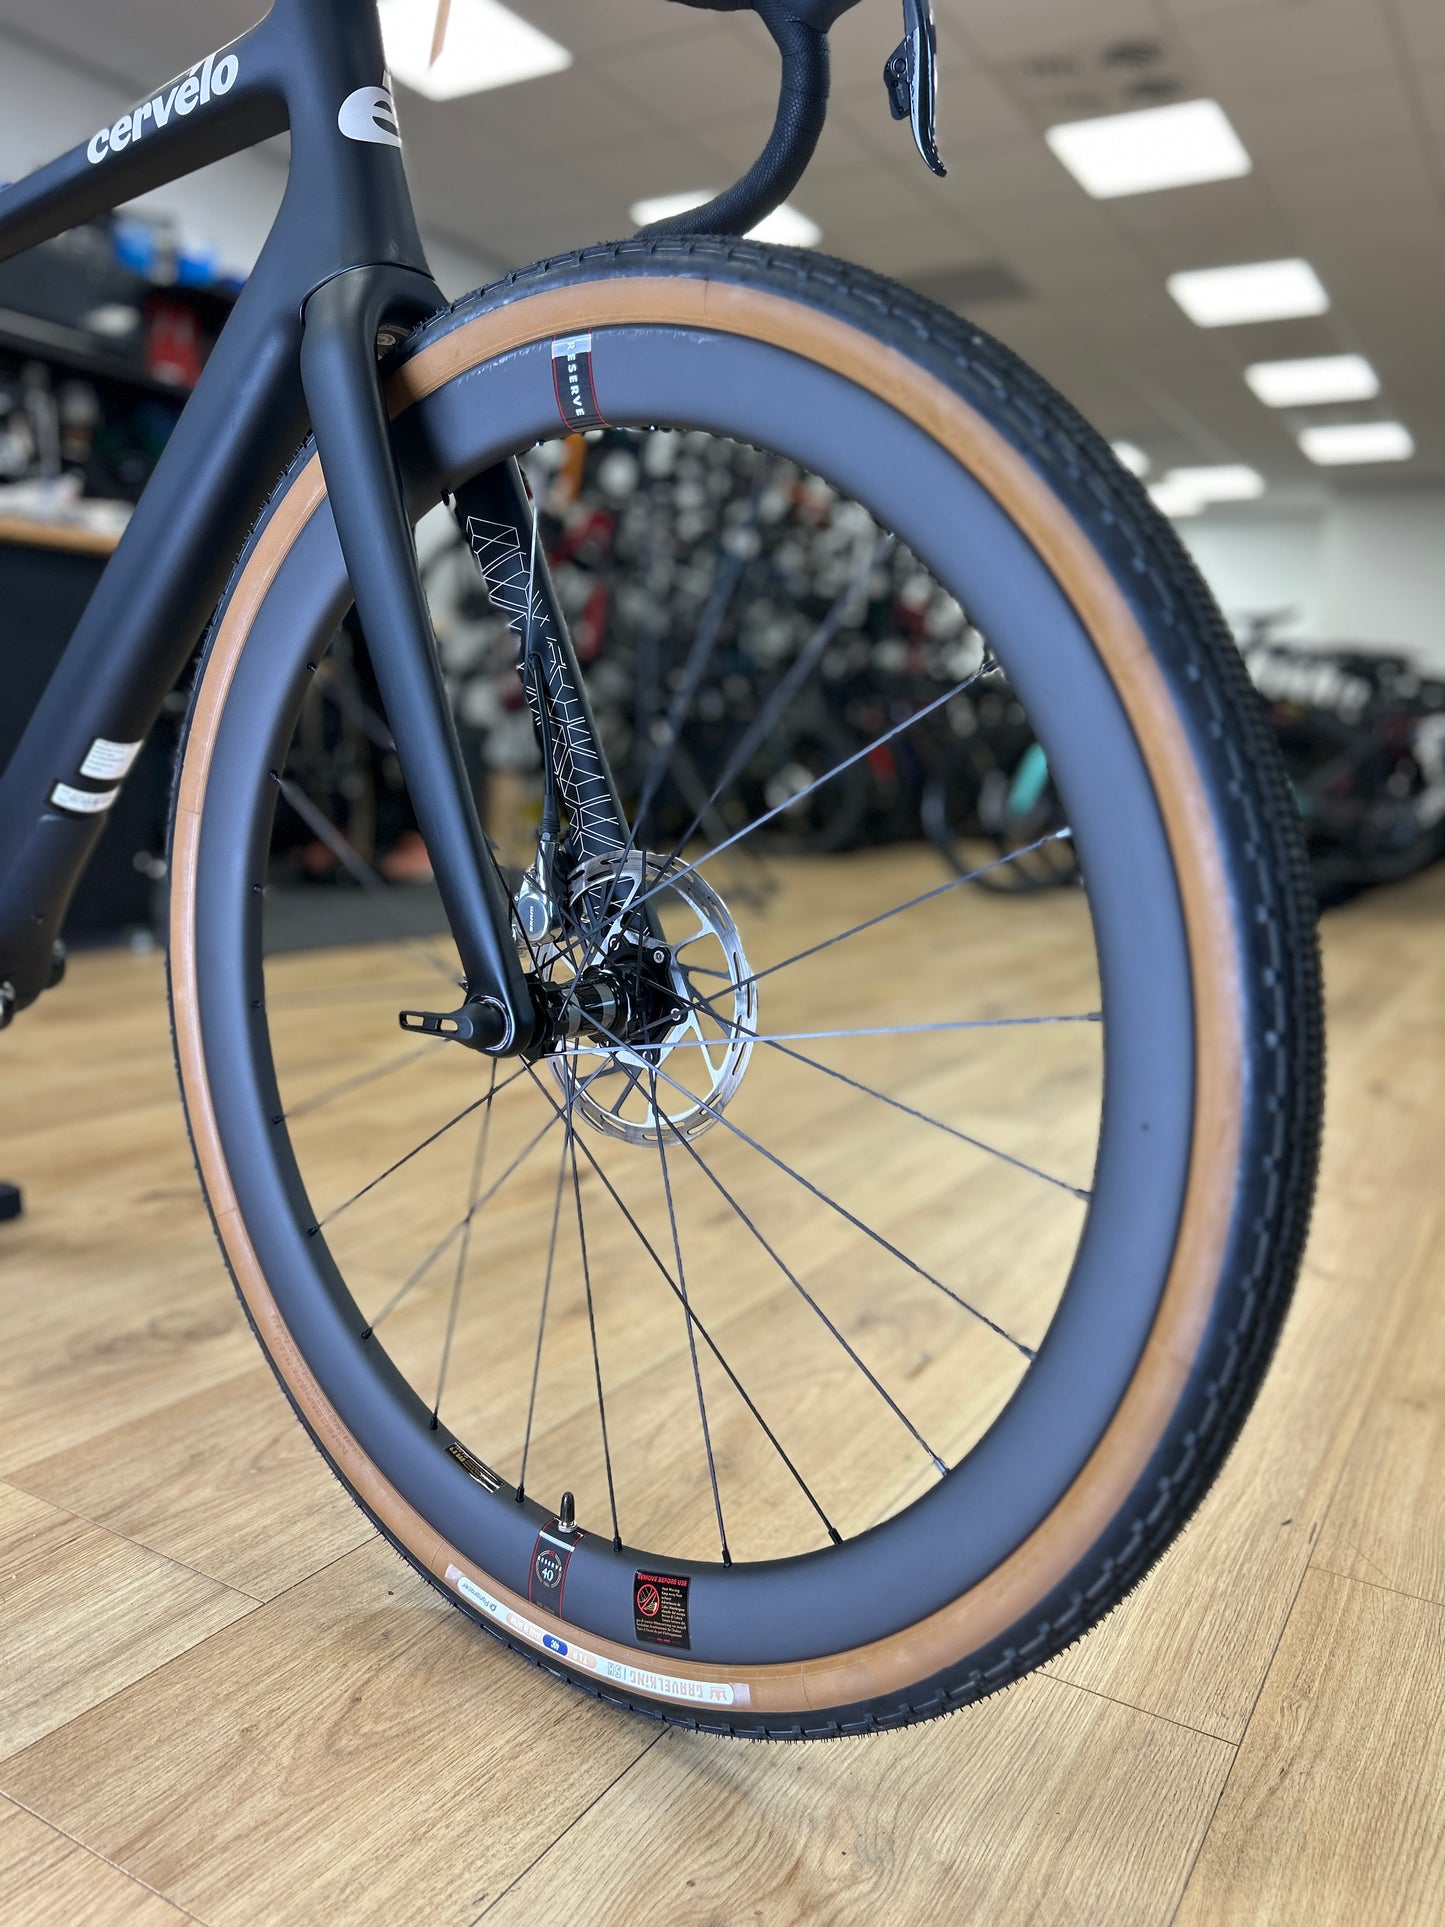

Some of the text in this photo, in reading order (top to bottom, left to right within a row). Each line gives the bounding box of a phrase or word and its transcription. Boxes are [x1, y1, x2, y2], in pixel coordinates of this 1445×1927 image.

[87, 53, 239, 164] cervélo
[567, 342, 585, 416] RESERVE
[542, 1567, 554, 1581] 40
[637, 1572, 688, 1587] REMOVE BEFORE USE
